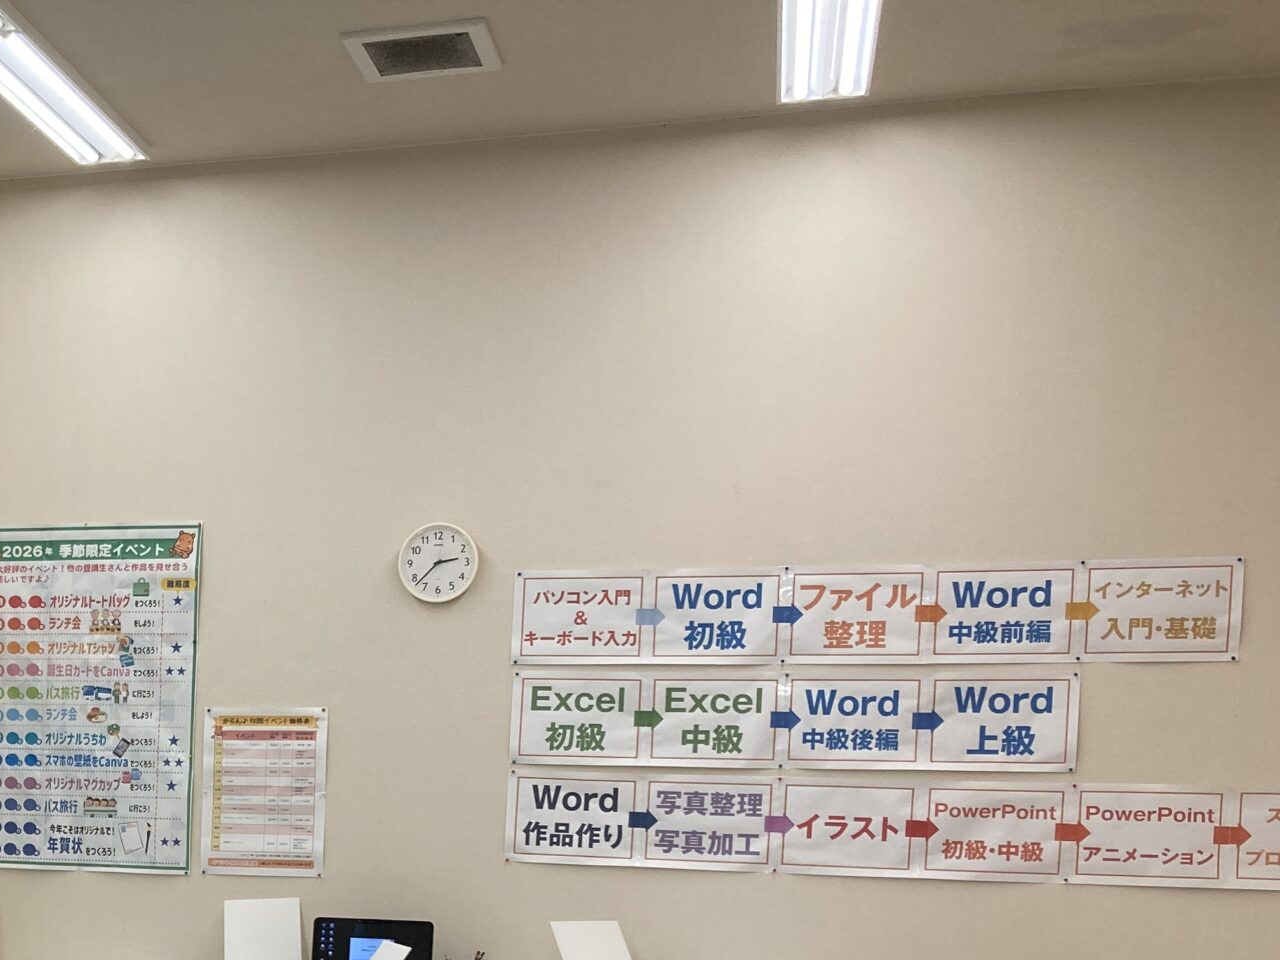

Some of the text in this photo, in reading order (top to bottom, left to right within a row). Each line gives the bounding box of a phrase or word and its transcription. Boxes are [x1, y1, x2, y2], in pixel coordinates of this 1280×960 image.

[421, 536, 429, 544] 11
[433, 531, 444, 540] 12
[2, 543, 165, 558] 2026年 季節限定イベント
[411, 546, 421, 555] 10
[460, 544, 466, 553] 2
[407, 559, 413, 568] 9
[464, 557, 470, 566] 3
[411, 573, 418, 582] 8
[422, 582, 428, 591] 7
[448, 581, 455, 590] 5
[458, 572, 465, 580] 4
[435, 585, 441, 594] 6
[533, 590, 631, 606] パソコン入門
[672, 583, 762, 610] Word
[799, 582, 917, 611] ファイル
[952, 580, 1052, 608] Word
[1094, 580, 1228, 599] インターネット
[574, 612, 588, 625] &
[1100, 617, 1217, 641] 入門・基礎
[524, 630, 637, 647] キーボード入力
[684, 620, 747, 650] 初級
[823, 620, 887, 650] 整理
[948, 620, 1052, 644] 中級前編
[530, 686, 625, 712] Excel
[664, 688, 762, 714] Excel
[805, 689, 899, 716] Word
[954, 686, 1053, 714] Word
[545, 722, 606, 752] 初級
[681, 725, 743, 754] 中級
[802, 728, 899, 751] 中級後編
[966, 725, 1036, 756] 上級
[532, 784, 619, 812] Word
[656, 790, 763, 818] 写真整理
[934, 803, 1057, 820] PowerPoint
[1085, 806, 1215, 823] PowerPoint
[522, 821, 624, 849] 作品作り
[796, 814, 899, 842] イラスト
[654, 829, 760, 857] 写真加工
[941, 839, 1044, 862] 初級・中級
[1082, 847, 1215, 865] アニメーション
